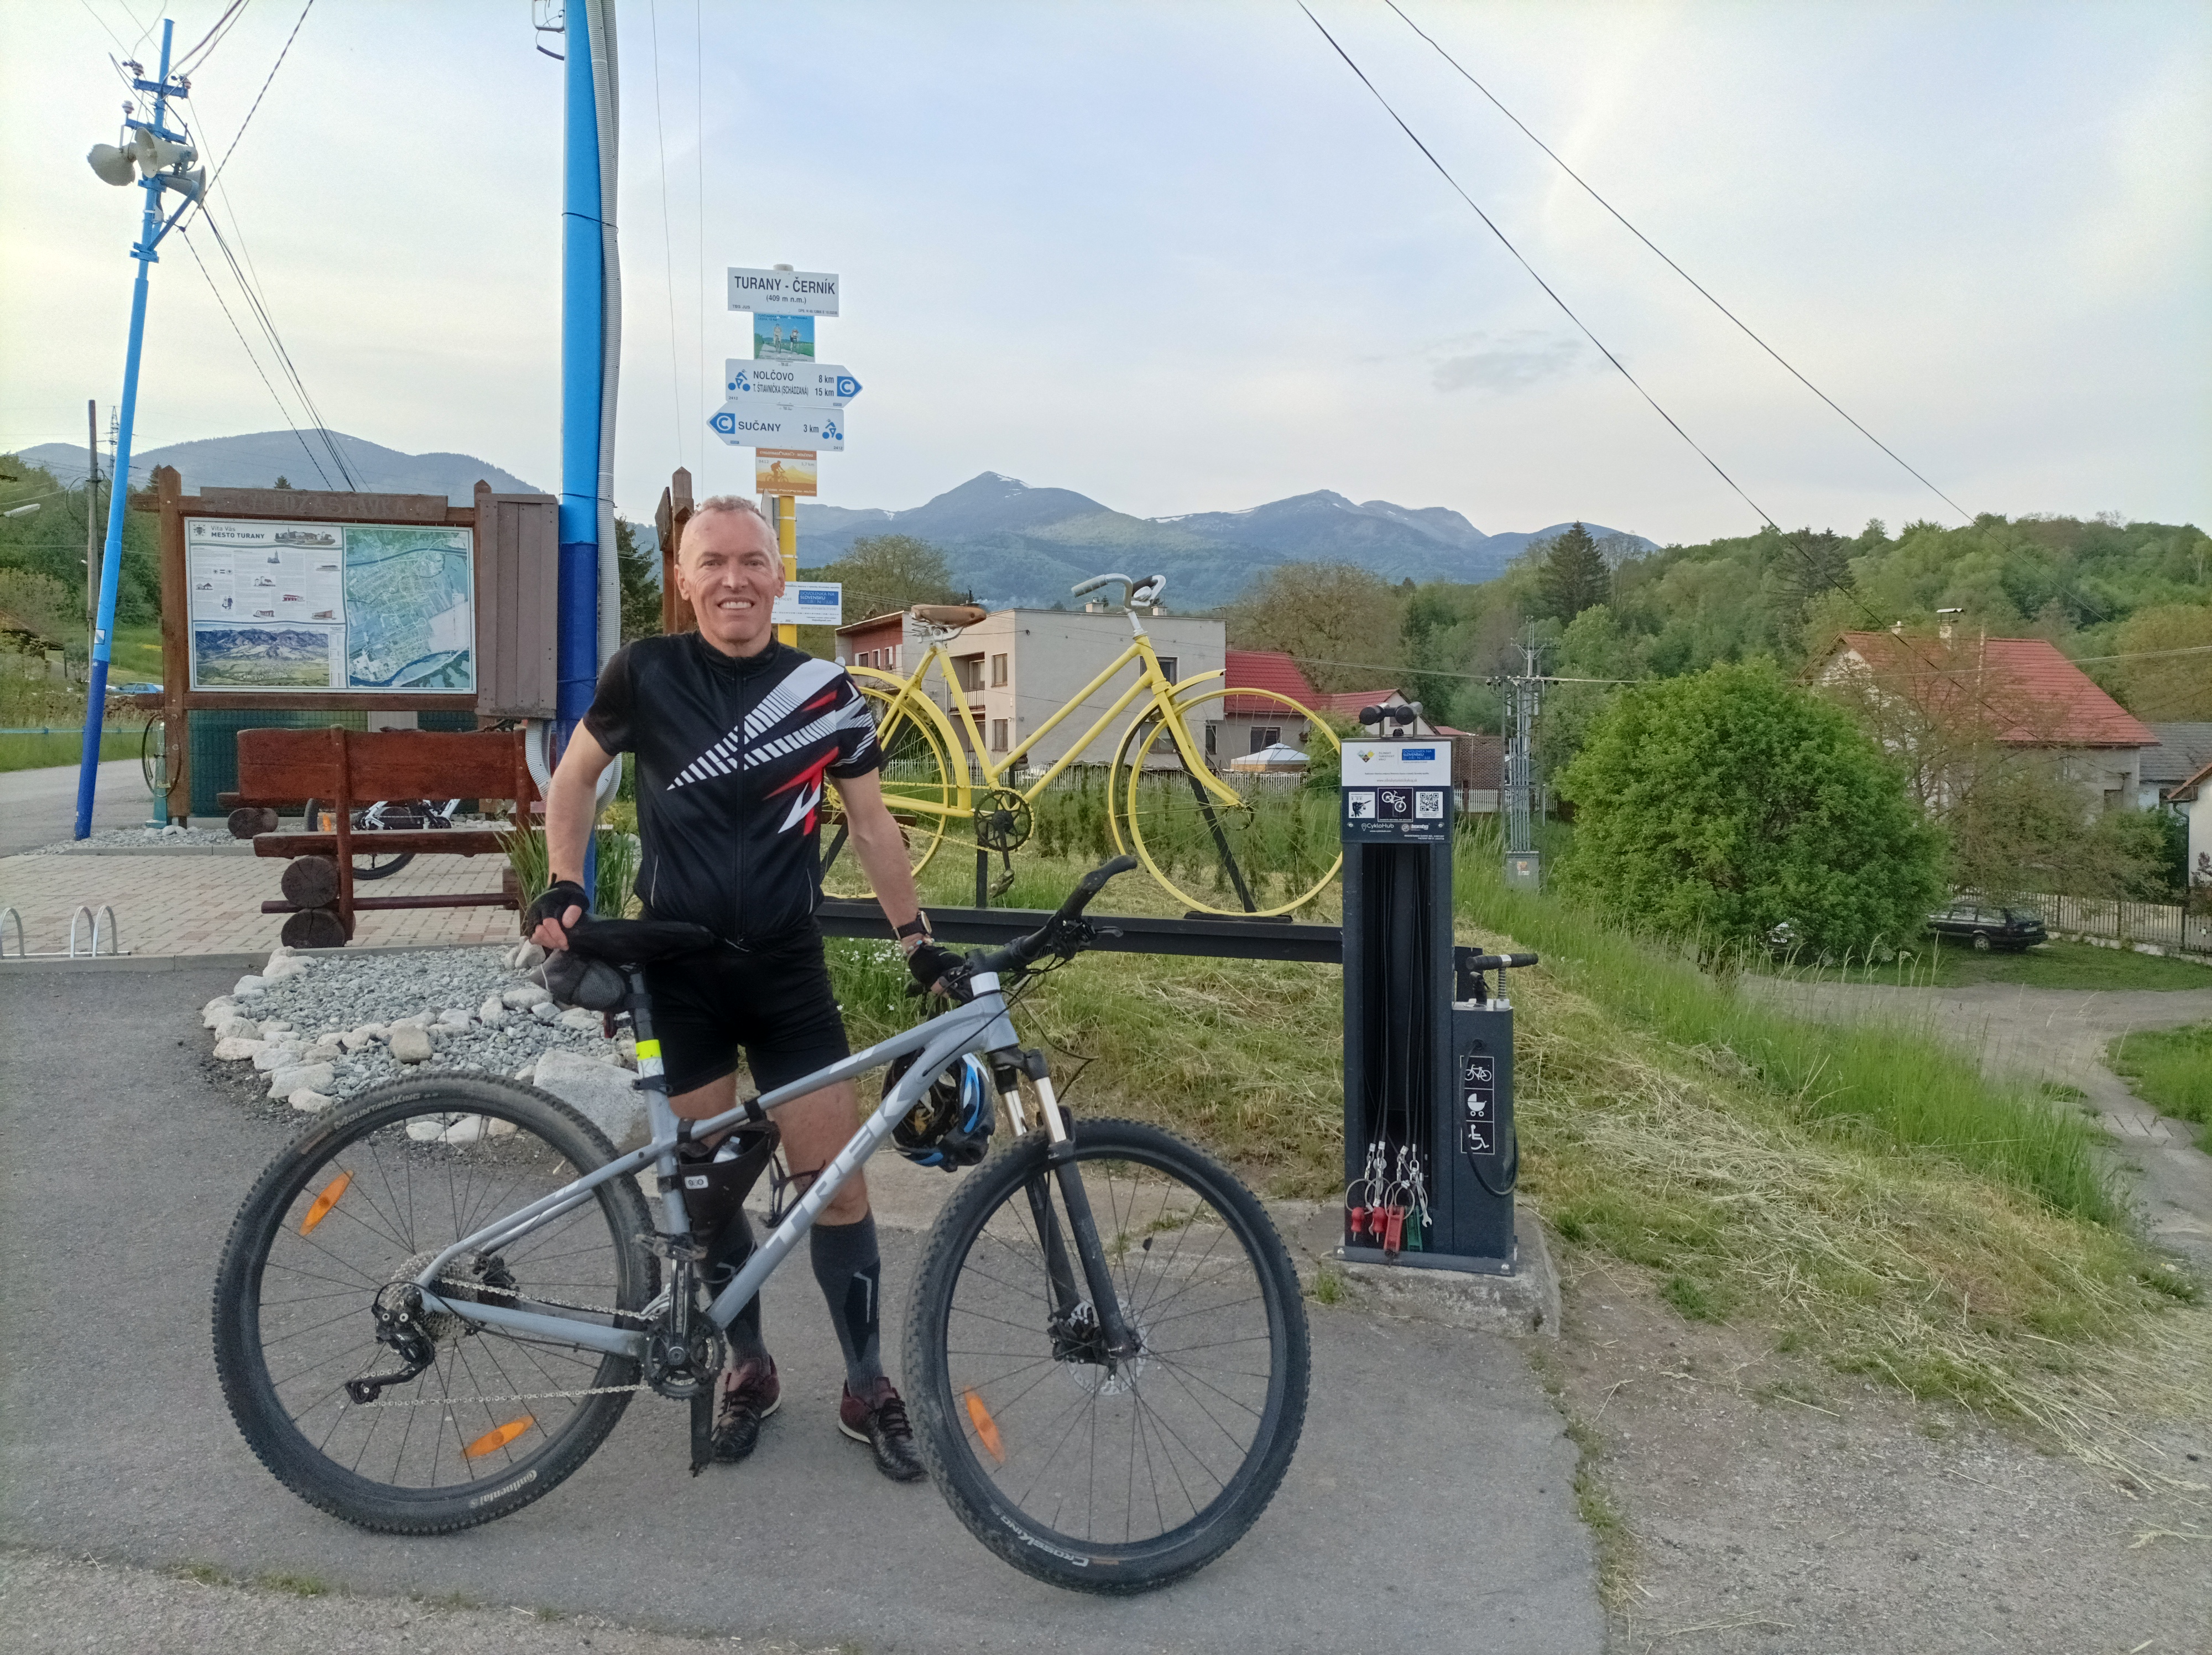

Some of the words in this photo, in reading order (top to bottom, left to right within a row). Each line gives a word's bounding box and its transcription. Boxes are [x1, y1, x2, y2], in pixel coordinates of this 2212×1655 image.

[734, 275, 781, 290] TURANY
[792, 277, 836, 294] ČERNÍK
[766, 294, 780, 303] (409
[790, 296, 806, 304] n.m.)
[753, 369, 794, 381] NOLČOVO
[825, 375, 834, 383] km
[815, 388, 822, 396] 15
[825, 388, 834, 397] km
[738, 420, 781, 432] SUČANY
[804, 424, 807, 433] 3
[809, 424, 819, 433] km
[765, 1081, 911, 1249] TREK
